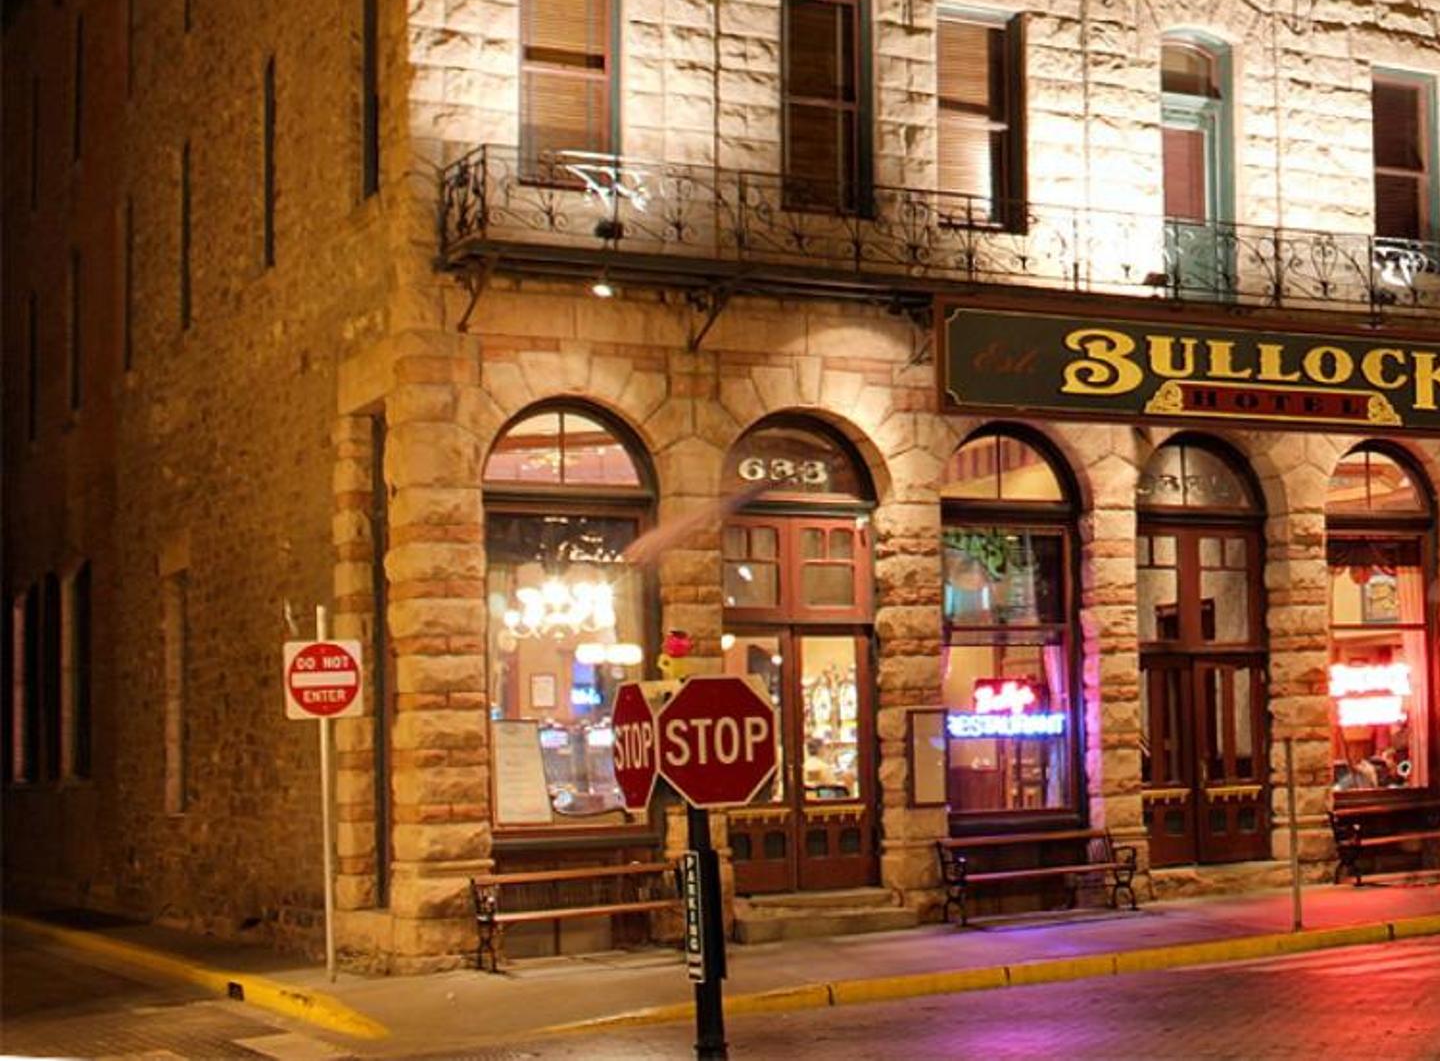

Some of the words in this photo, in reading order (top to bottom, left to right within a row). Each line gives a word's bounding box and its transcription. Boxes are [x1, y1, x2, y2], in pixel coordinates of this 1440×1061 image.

[1192, 389, 1361, 414] HOTEL
[739, 458, 828, 484] 633
[296, 657, 316, 670] DO
[322, 655, 349, 669] NOT
[302, 688, 347, 704] ENTER
[614, 720, 653, 771] STOP
[664, 716, 769, 766] STOP
[686, 855, 700, 952] PARKING
